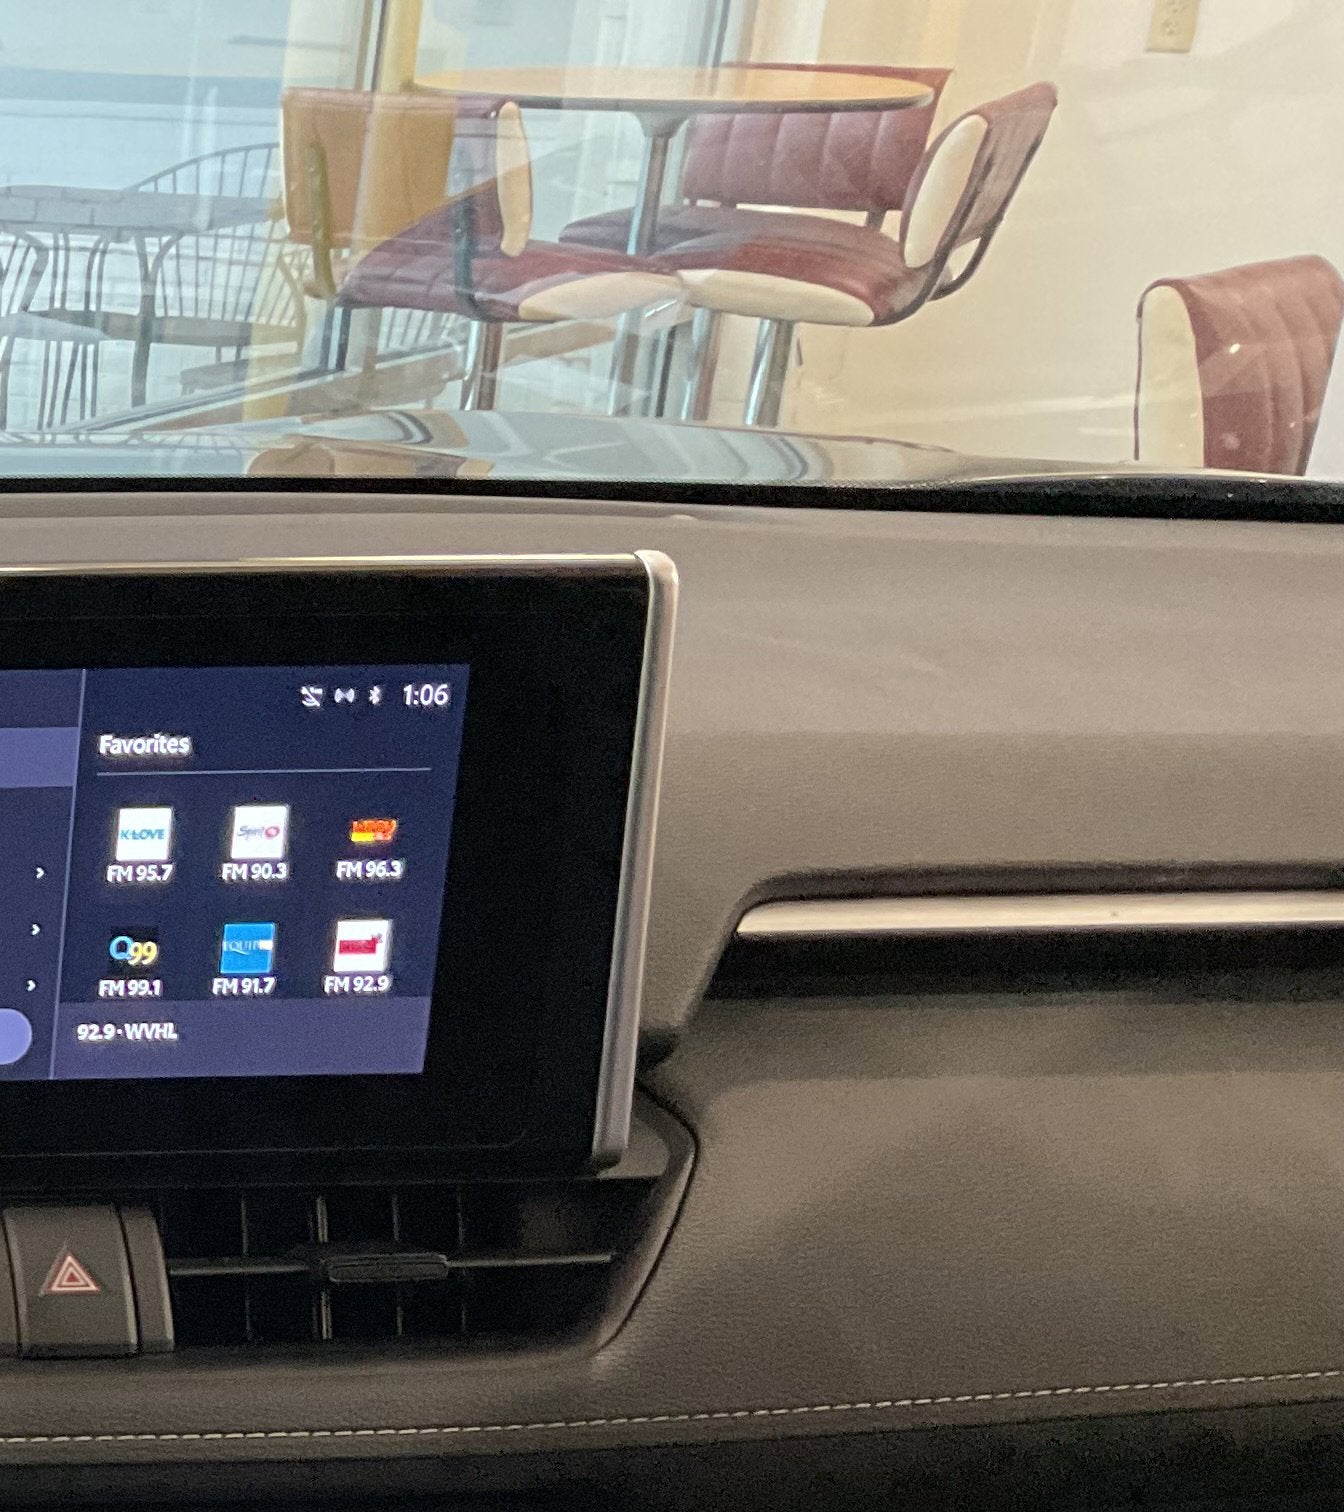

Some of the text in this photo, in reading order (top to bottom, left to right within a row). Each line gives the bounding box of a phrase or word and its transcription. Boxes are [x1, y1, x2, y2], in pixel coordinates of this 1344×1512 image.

[402, 684, 450, 707] 1:06
[98, 733, 192, 756] Favorites
[106, 863, 174, 882] FM 95.7
[221, 862, 288, 881] FM 90.3
[336, 860, 403, 879] FM 96.3
[109, 935, 159, 966] Q99
[98, 978, 162, 997] FM 99.1
[212, 976, 276, 994] FM 91.7
[324, 974, 391, 993] FM 92.9
[124, 1022, 179, 1040] WVHL
